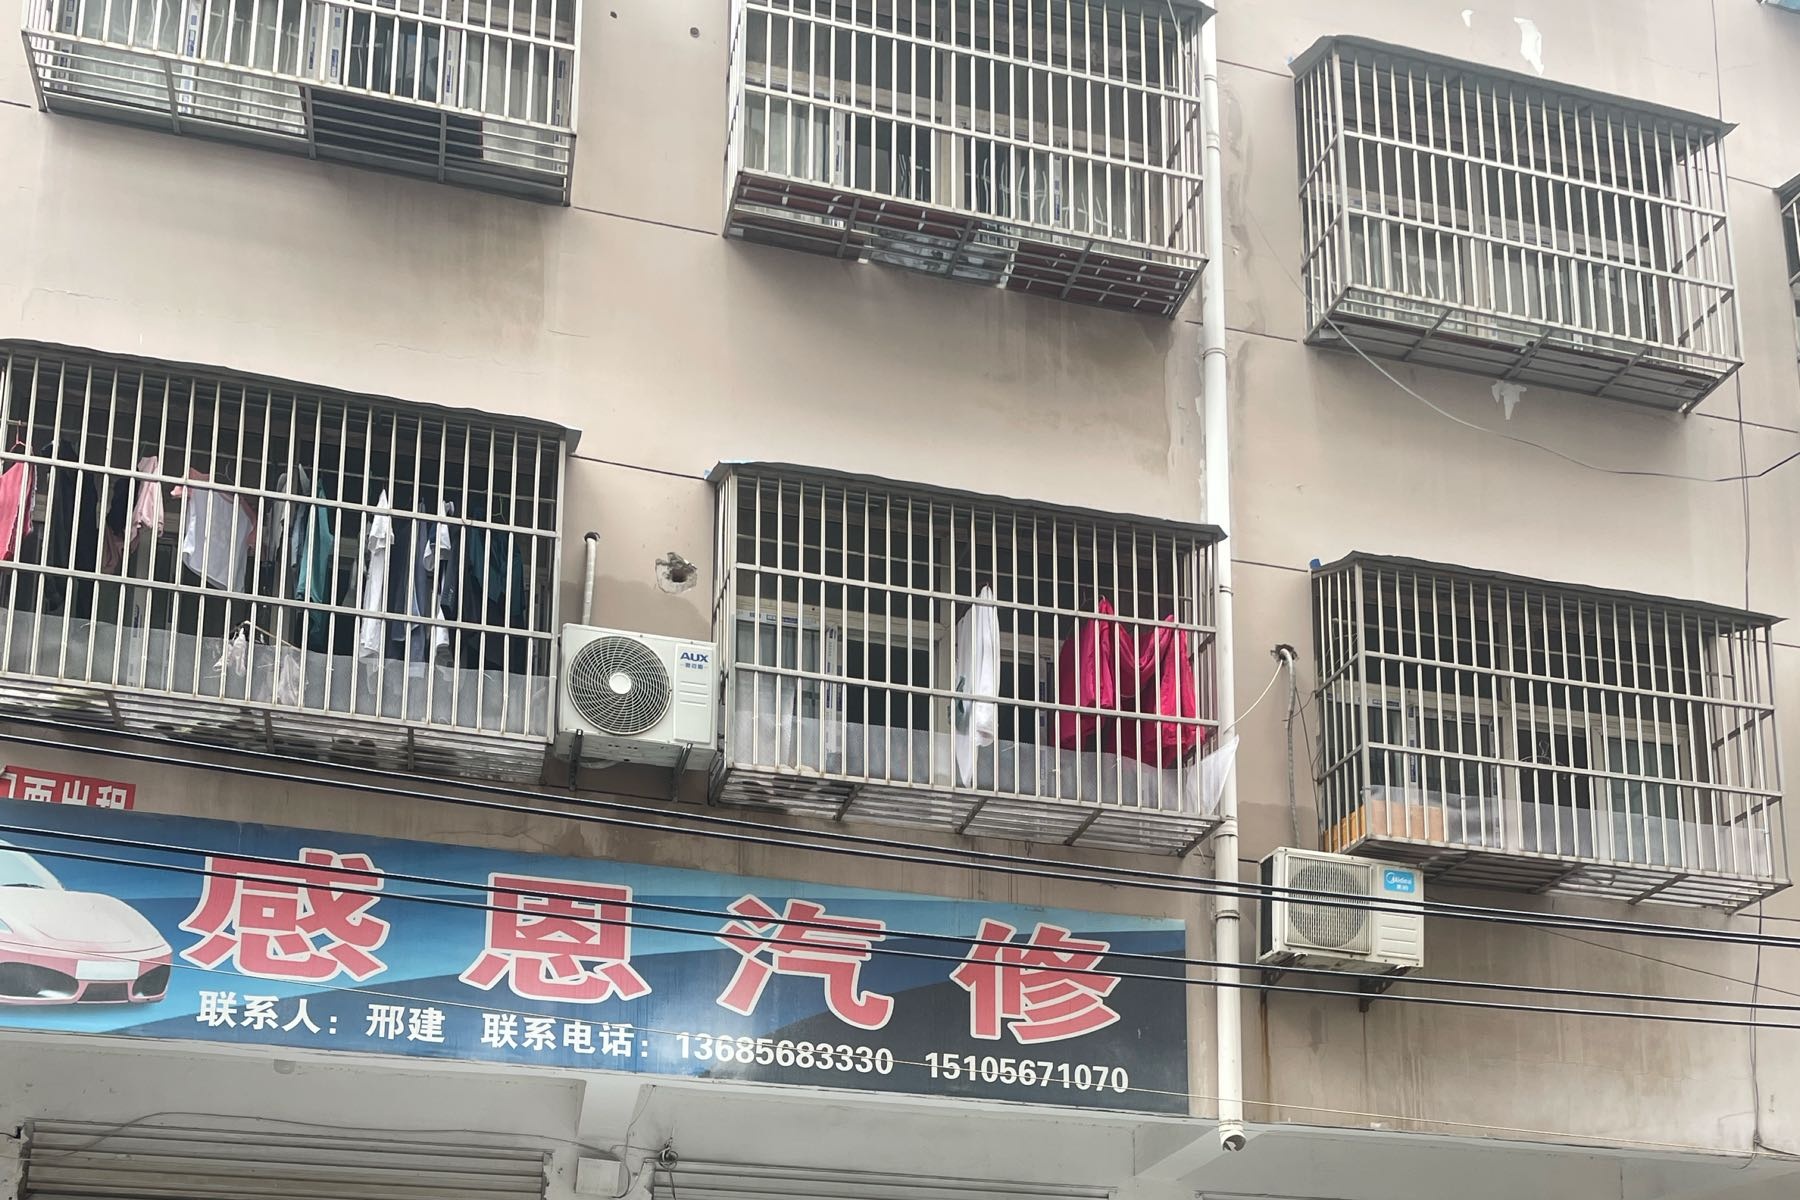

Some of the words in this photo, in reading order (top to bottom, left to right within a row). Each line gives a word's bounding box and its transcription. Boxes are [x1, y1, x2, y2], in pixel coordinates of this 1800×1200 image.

[681, 652, 708, 663] AUX
[178, 848, 1122, 1044] 感恩汽修
[924, 1051, 1129, 1094] 15105671070
